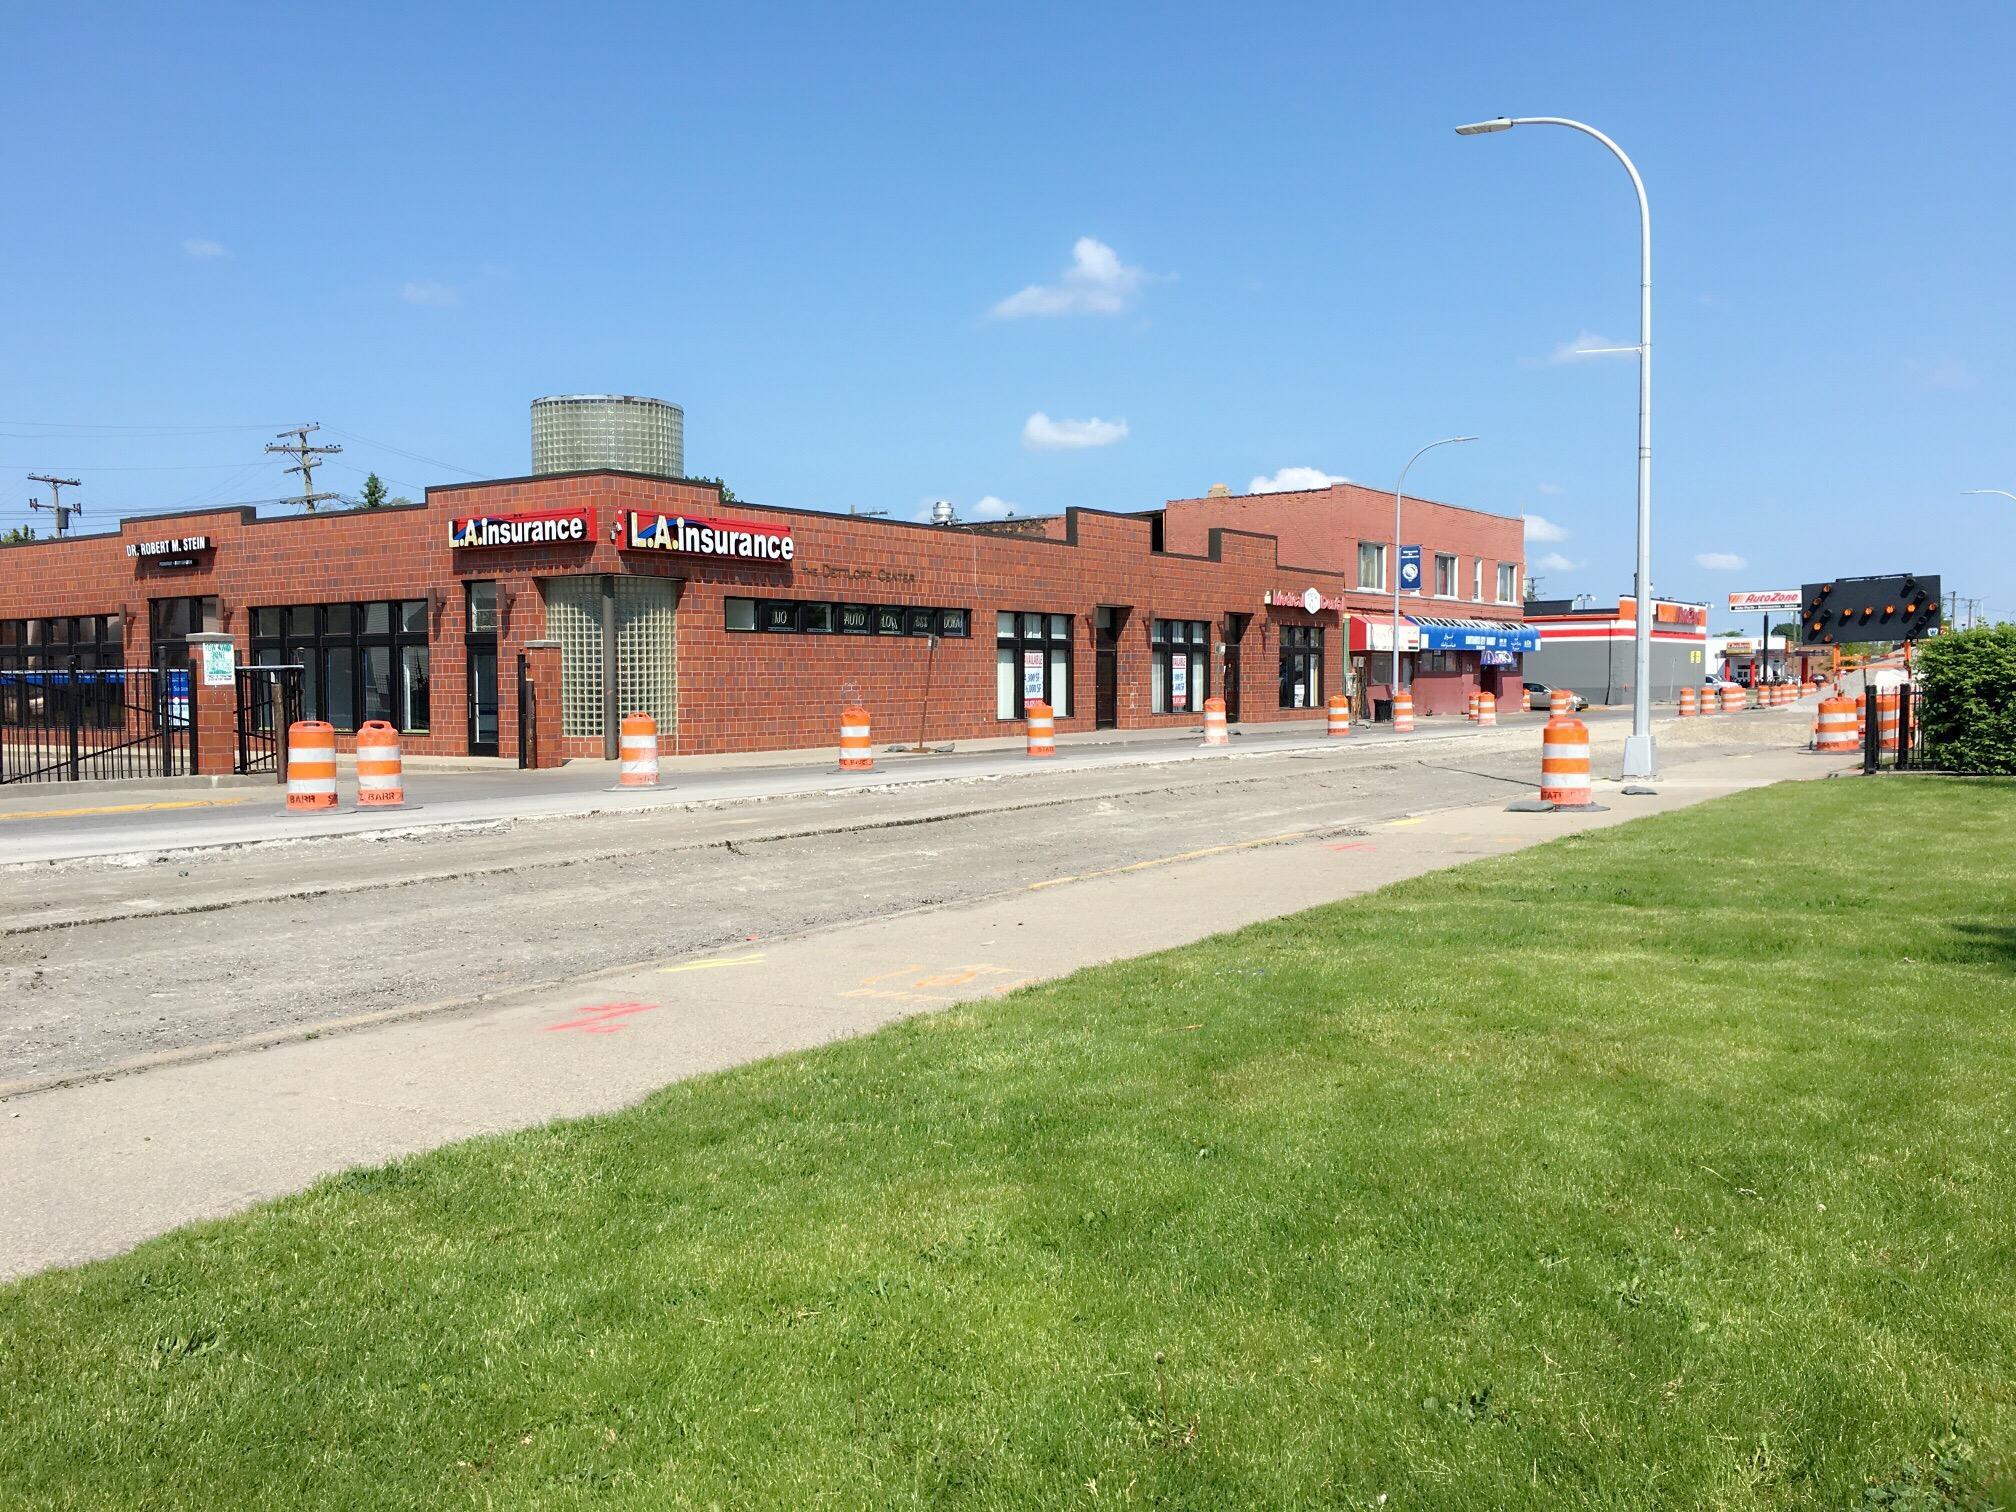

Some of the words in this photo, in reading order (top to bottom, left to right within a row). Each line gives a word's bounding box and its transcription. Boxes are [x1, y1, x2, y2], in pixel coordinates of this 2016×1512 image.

[126, 544, 139, 557] DR.
[140, 540, 170, 555] ROBERT
[171, 539, 182, 552] M.
[183, 536, 205, 551] STEIN
[1746, 592, 1799, 603] AutoZone
[774, 611, 787, 624] NO
[844, 614, 865, 626] AUTO
